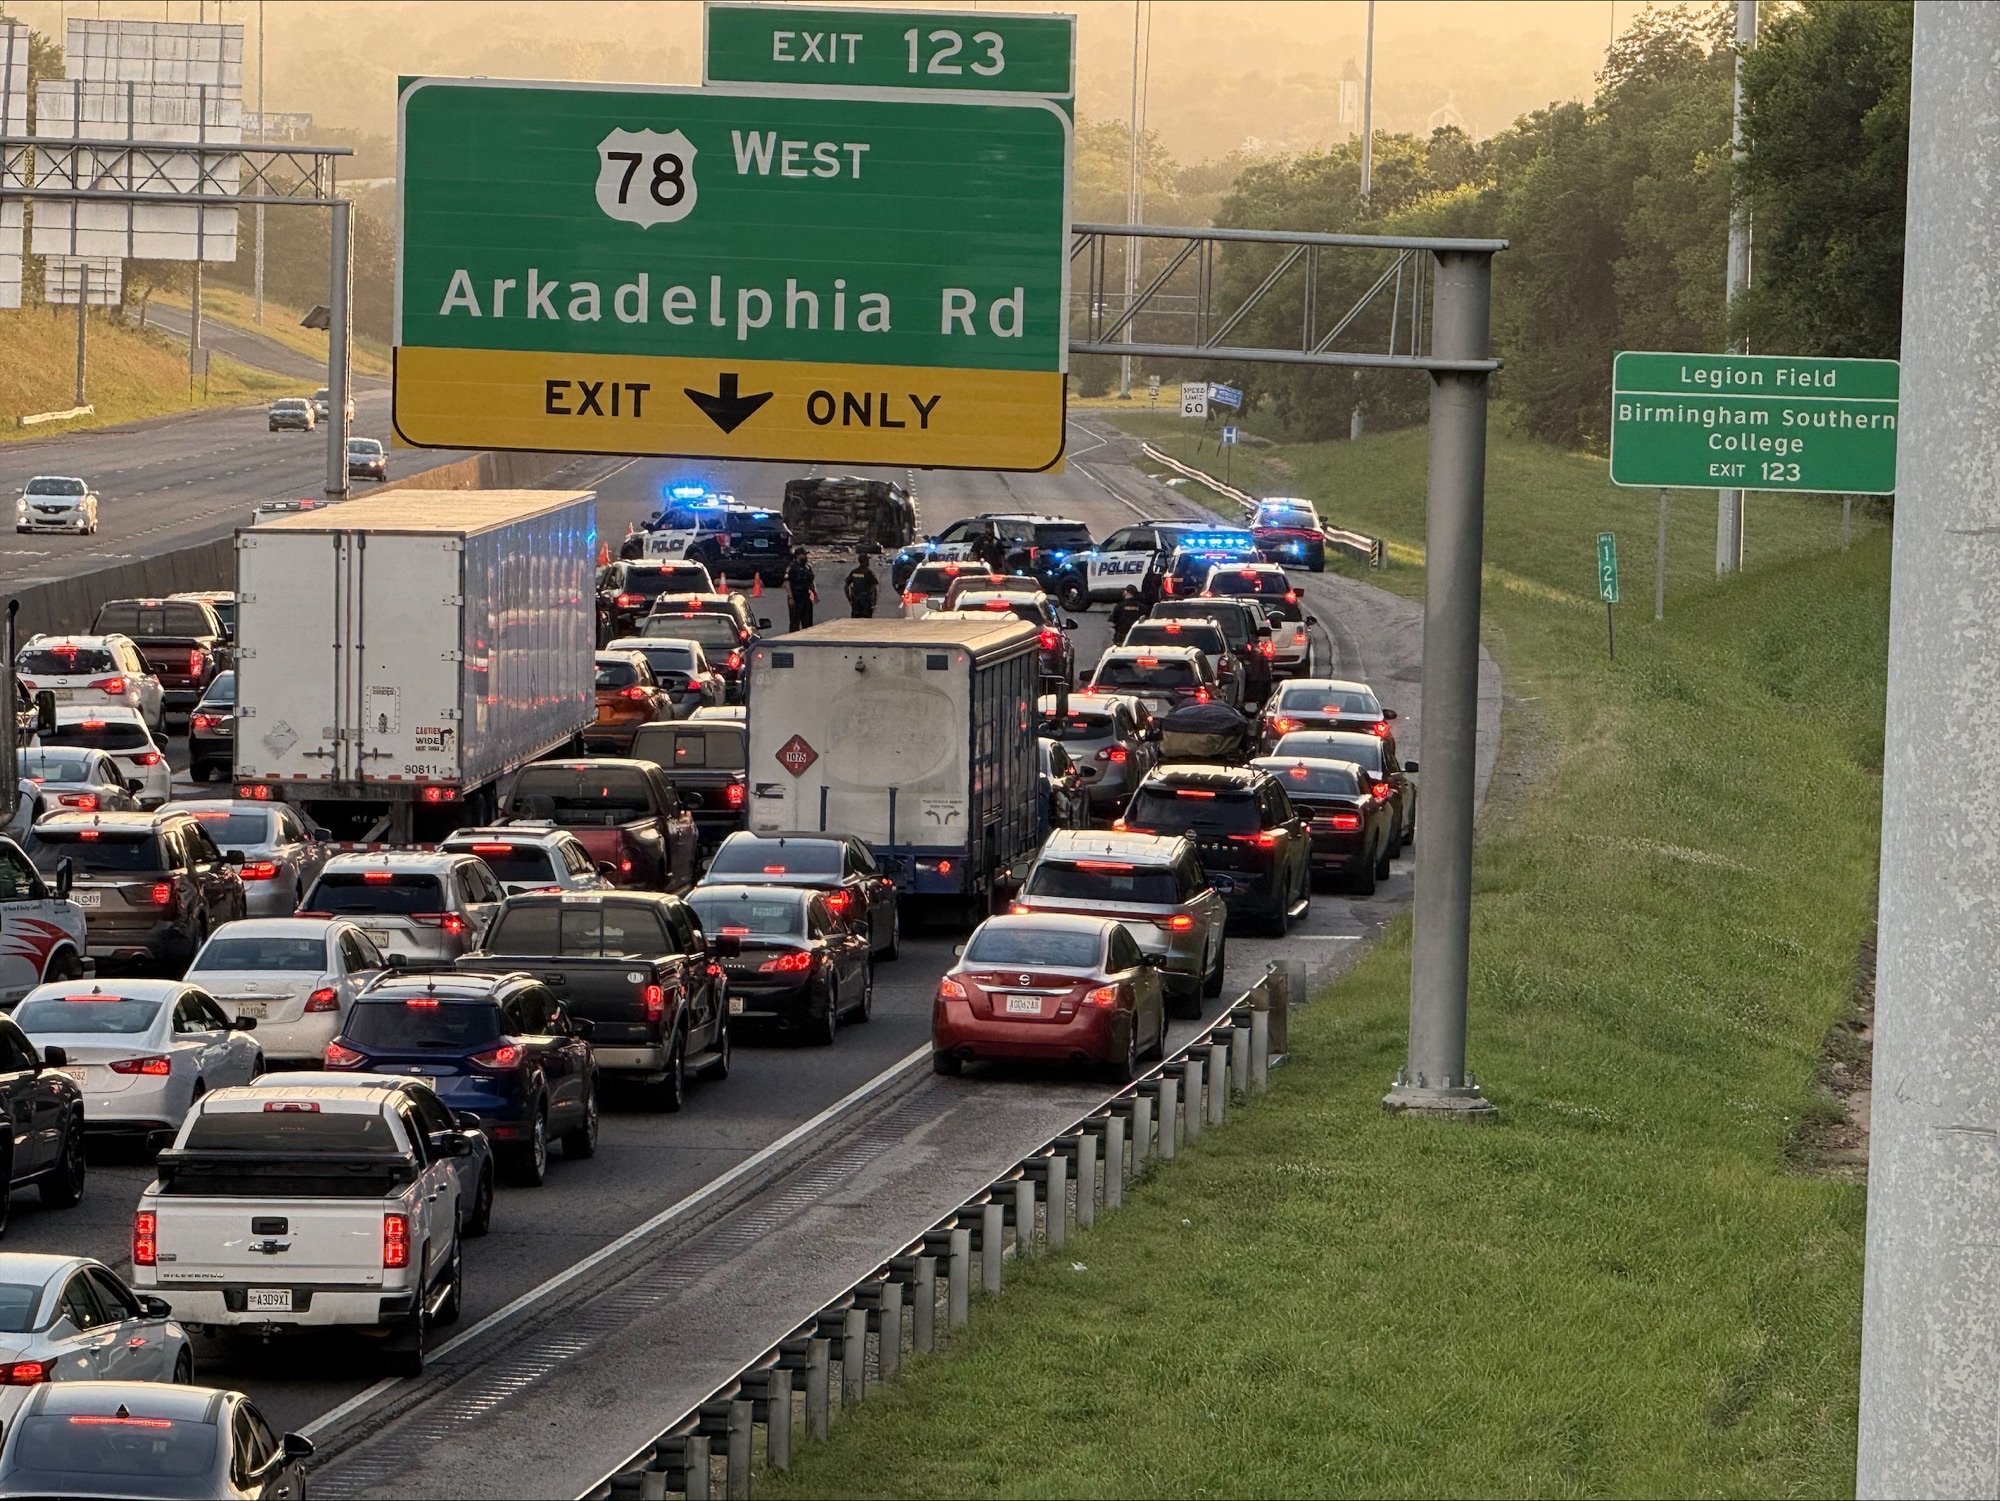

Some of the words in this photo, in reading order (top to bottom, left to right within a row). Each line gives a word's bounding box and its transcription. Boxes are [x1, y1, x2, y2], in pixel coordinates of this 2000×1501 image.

[772, 31, 863, 64] EXIT
[903, 29, 1006, 77] 123
[731, 129, 871, 180] WEST
[606, 151, 686, 207] 78
[439, 268, 892, 341] Arkadelphia
[940, 287, 1024, 338] Rd
[1681, 366, 1763, 389] Legion
[1776, 369, 1836, 388] Field
[544, 379, 651, 418] EXIT
[806, 390, 942, 429] ONLY
[1185, 403, 1204, 413] 60
[1618, 403, 1769, 428] Birmingham
[1782, 409, 1896, 430] Southern
[1223, 427, 1237, 444] H
[1708, 433, 1804, 456] College
[1709, 463, 1746, 478] EXIT
[1761, 462, 1801, 482] 123
[1098, 560, 1145, 576] POLICE
[415, 737, 440, 745] WIDE
[787, 752, 806, 762] 1075
[404, 764, 437, 774] 90811
